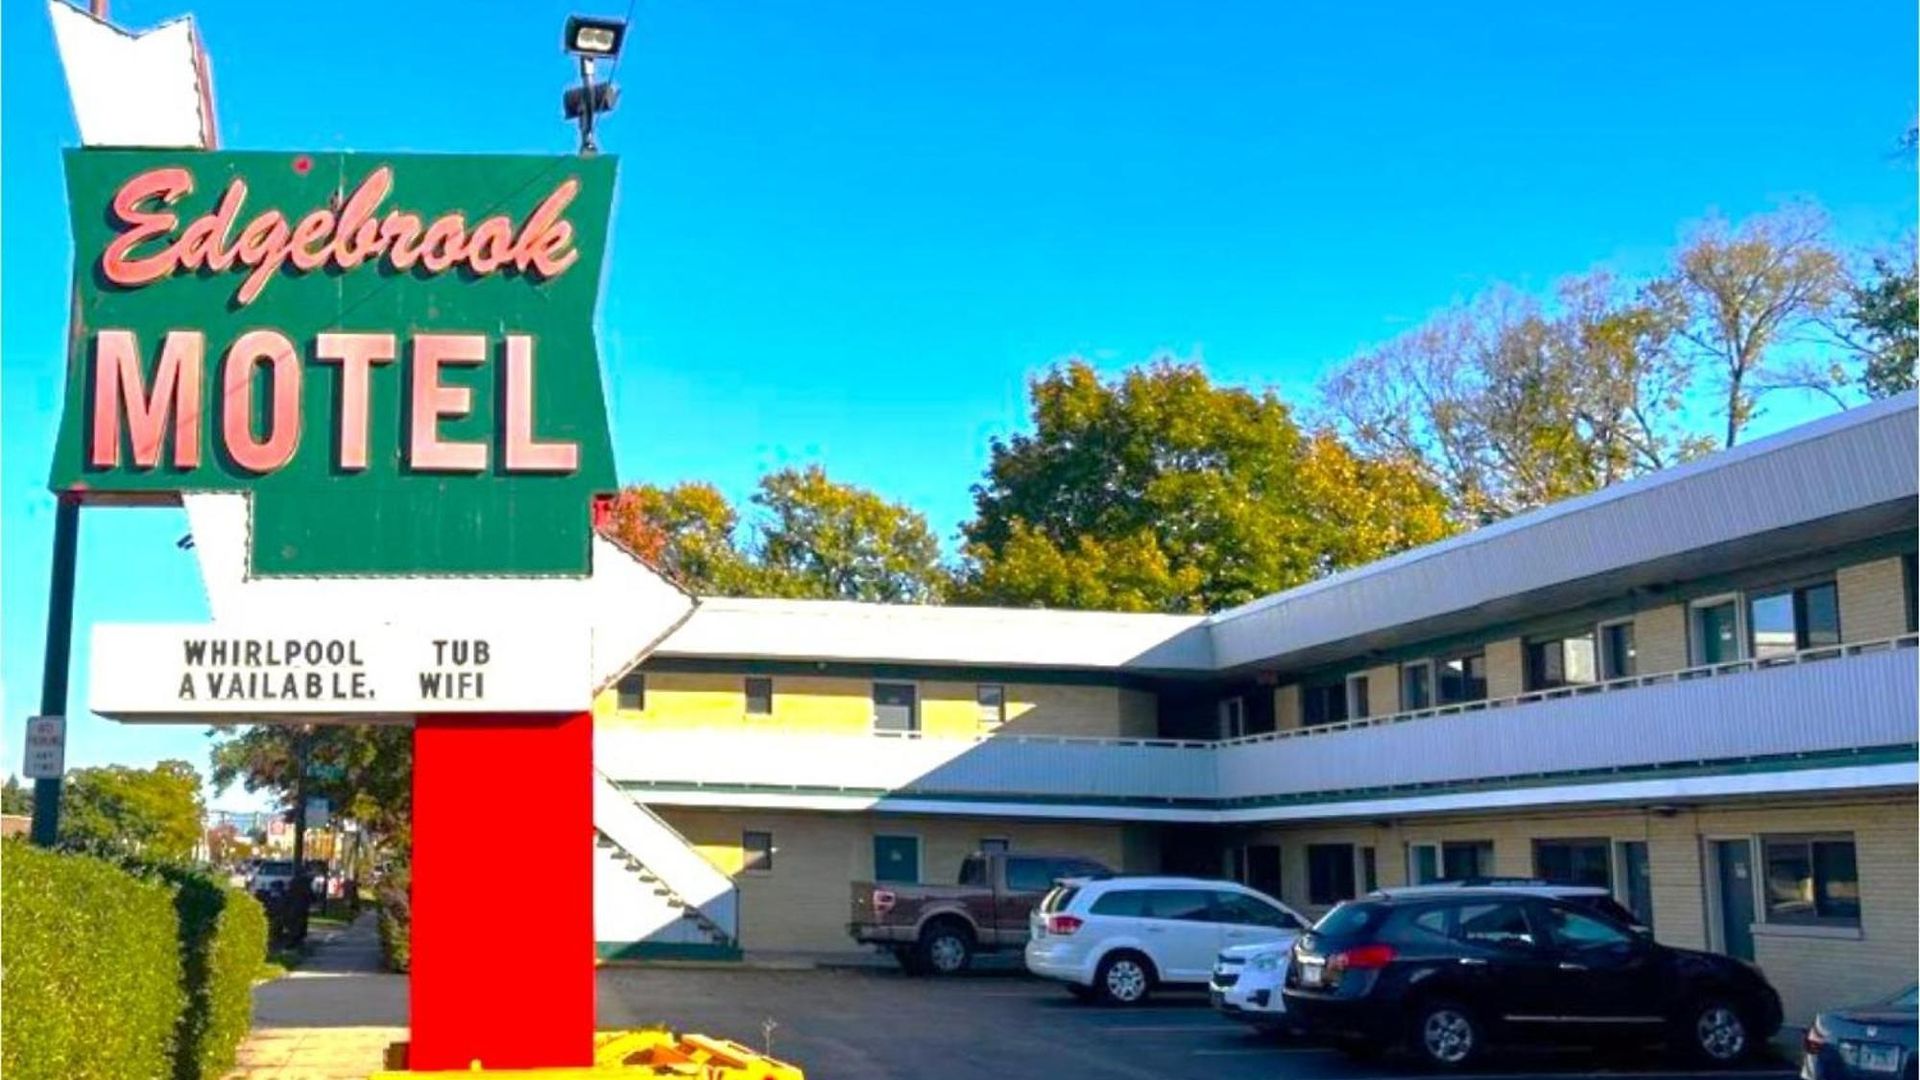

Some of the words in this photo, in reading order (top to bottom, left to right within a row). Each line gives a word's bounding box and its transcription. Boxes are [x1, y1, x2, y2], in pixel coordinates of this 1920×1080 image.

[101, 166, 579, 305] Edgebrook
[90, 329, 579, 473] MOTEL
[183, 639, 364, 667] WHIRLPOOL
[432, 639, 490, 666] TUB
[419, 672, 484, 699] WIFI
